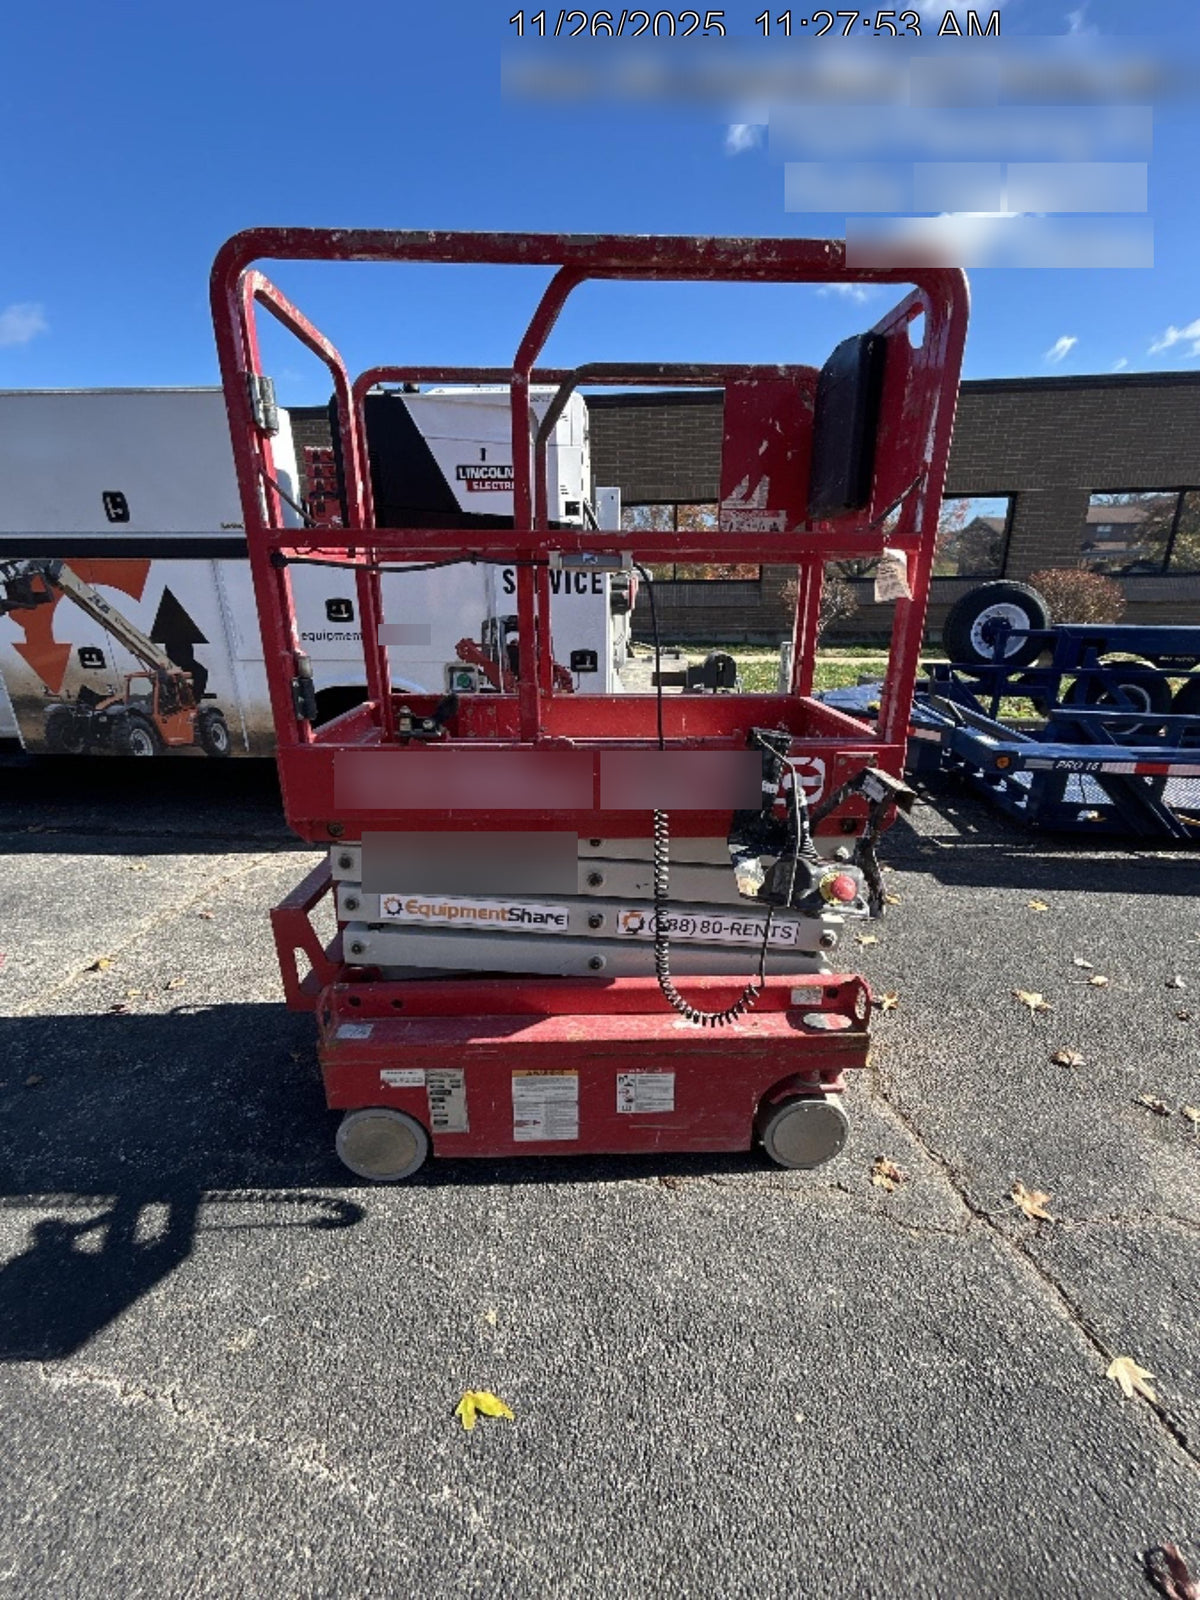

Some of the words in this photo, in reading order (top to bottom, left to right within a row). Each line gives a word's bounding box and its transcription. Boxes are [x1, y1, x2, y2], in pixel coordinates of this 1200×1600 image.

[458, 467, 514, 479] LINCOLN
[472, 481, 514, 490] ELECTRI
[502, 568, 603, 595] SVICE
[1055, 760, 1084, 770] PRO
[405, 899, 566, 925] EquipmentShare
[648, 915, 697, 936] (88)
